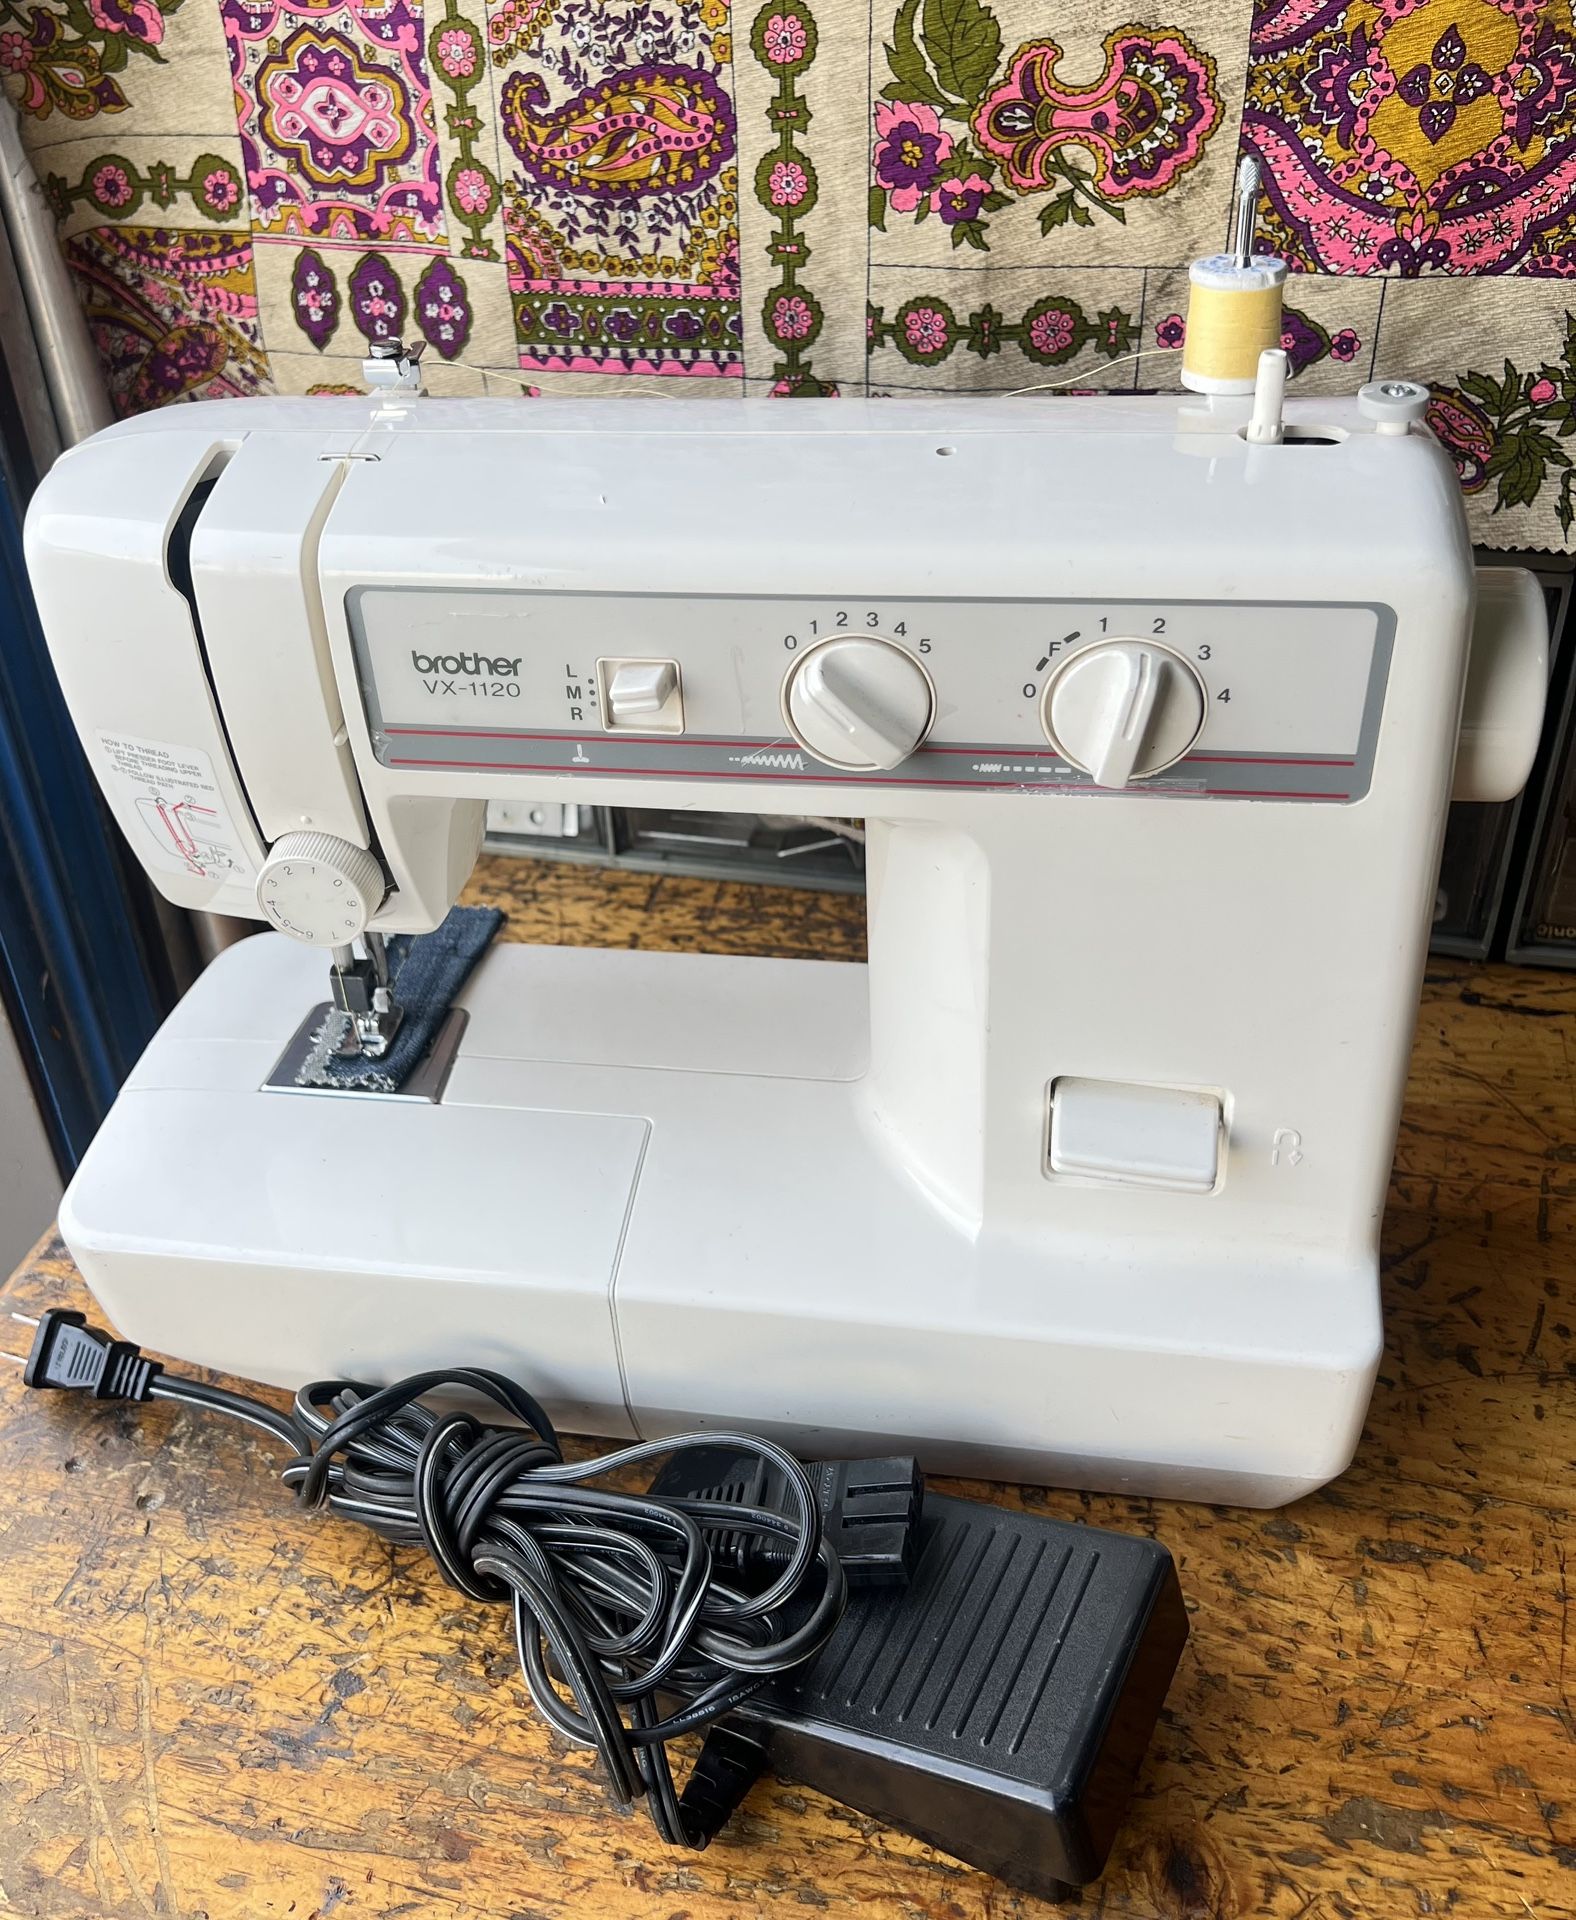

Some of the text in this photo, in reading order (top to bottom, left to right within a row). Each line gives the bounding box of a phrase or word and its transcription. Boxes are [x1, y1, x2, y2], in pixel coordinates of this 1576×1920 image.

[784, 612, 931, 653] 0 1 2 3 4 5
[411, 650, 522, 677] brother
[1023, 618, 1231, 704] 0 F 1 2 3 4
[567, 664, 577, 678] L
[423, 680, 521, 698] VX-1120
[566, 686, 582, 700] M
[571, 707, 583, 721] R
[101, 737, 169, 759] HOW TO THREAD
[284, 866, 293, 875] 2
[267, 879, 278, 887] 3
[305, 931, 314, 939] 6
[332, 931, 339, 940] 7
